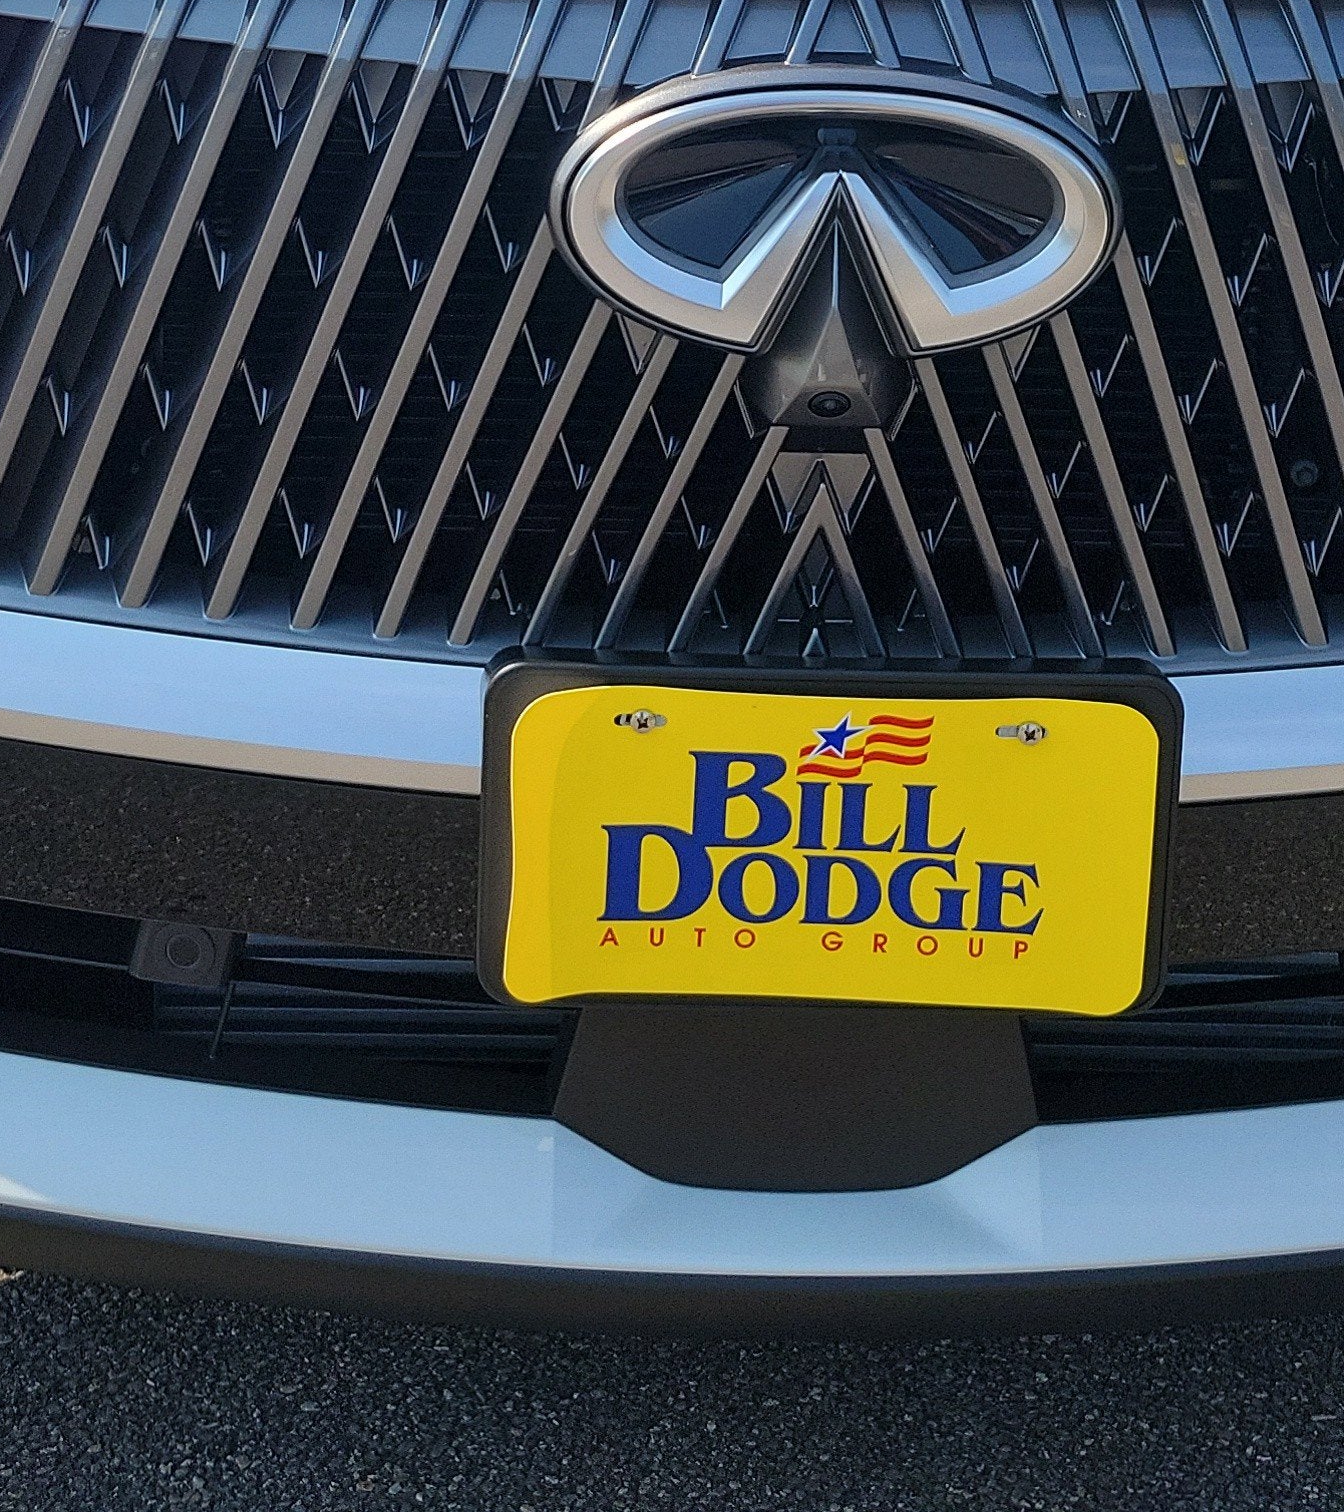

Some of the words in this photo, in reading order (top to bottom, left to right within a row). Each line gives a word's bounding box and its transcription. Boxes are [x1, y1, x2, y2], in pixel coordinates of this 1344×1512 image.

[689, 751, 966, 855] BILL
[597, 824, 1044, 936] DODGE
[599, 927, 756, 949] AUTO
[820, 932, 1030, 960] GROUP
